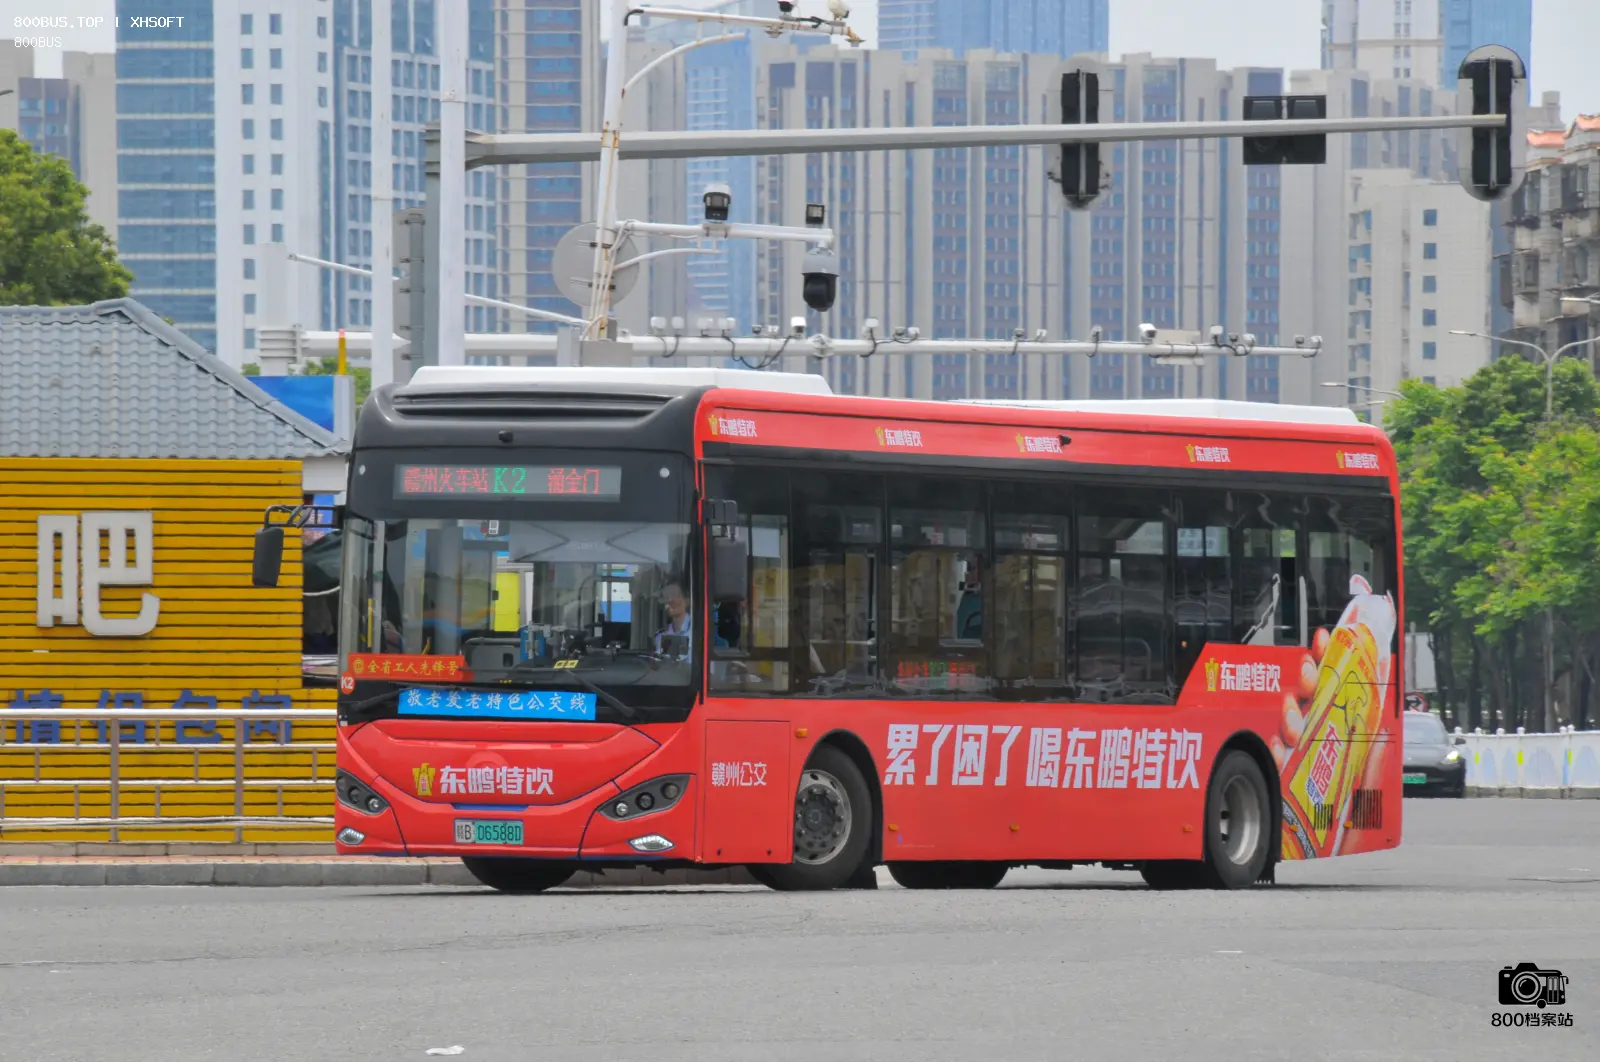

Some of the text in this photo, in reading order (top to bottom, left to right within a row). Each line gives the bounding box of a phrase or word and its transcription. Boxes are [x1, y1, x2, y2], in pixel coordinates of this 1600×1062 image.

[719, 416, 758, 437] 东鹏特饮
[884, 427, 923, 447] 东鹏特饮
[1024, 435, 1064, 454] 东鹏特饮
[1194, 445, 1231, 463] 东鹏特饮
[1343, 451, 1380, 470] 东鹏特饮
[493, 466, 527, 494] K2
[37, 510, 161, 637] 吧
[367, 659, 459, 676] 全省工人先锋号
[1220, 660, 1281, 692] 东鹏特饮
[341, 676, 354, 690] K2
[406, 688, 588, 714] 敬老爱老特色公交线
[440, 764, 555, 796] 东鹏特饮
[711, 761, 768, 787] 赣州公交
